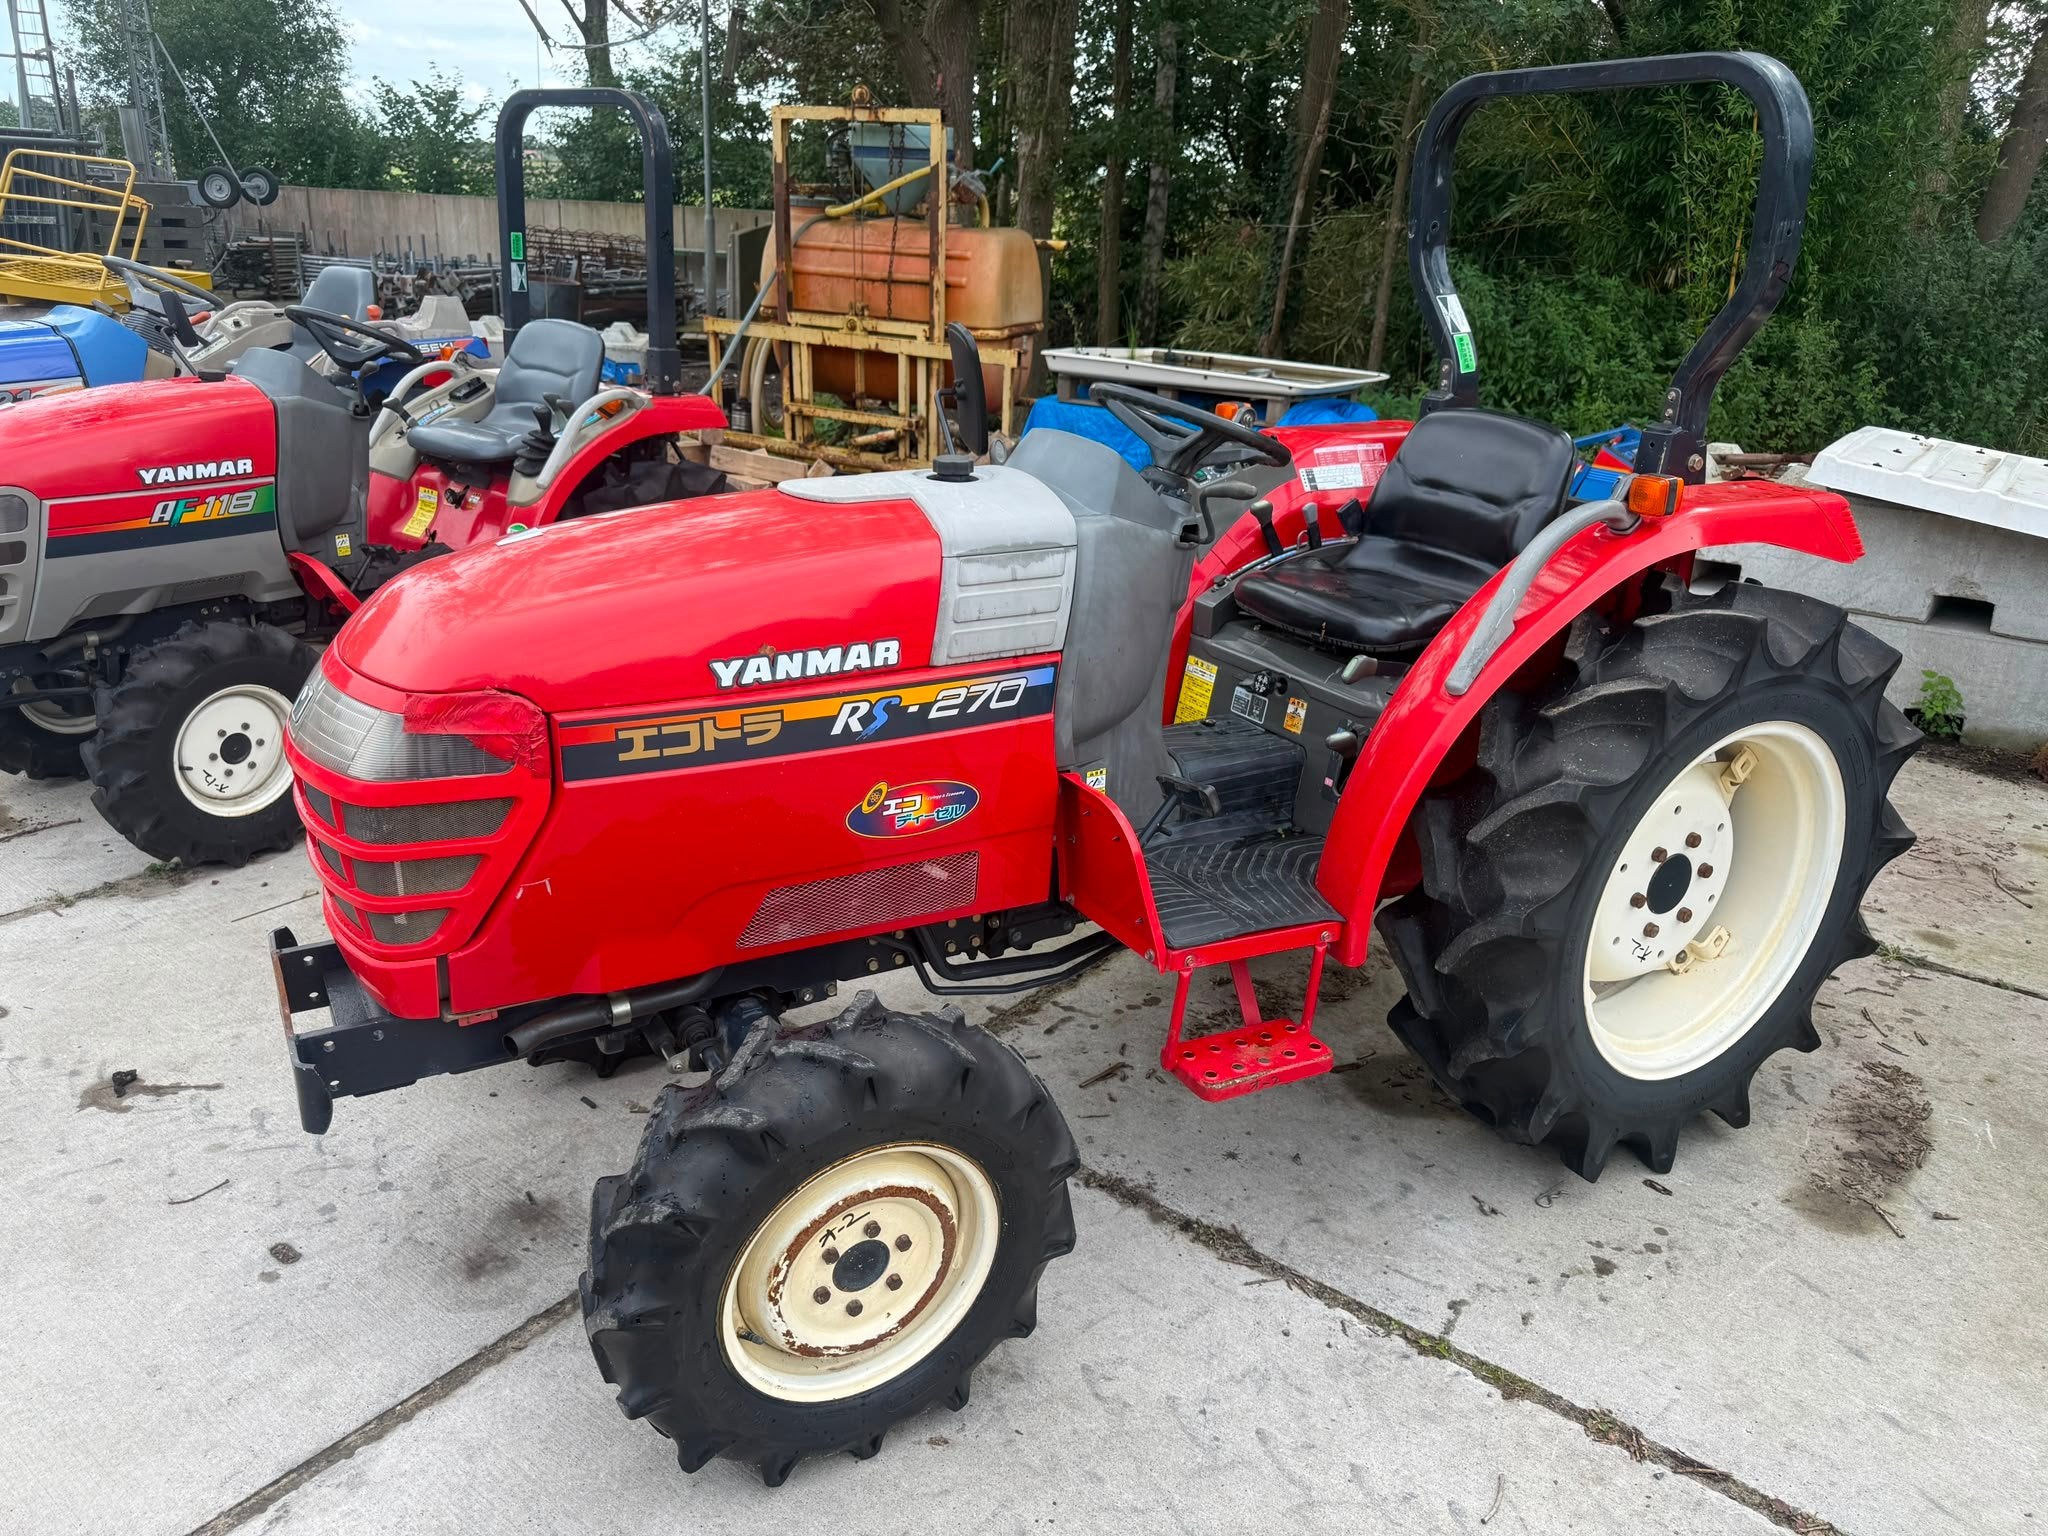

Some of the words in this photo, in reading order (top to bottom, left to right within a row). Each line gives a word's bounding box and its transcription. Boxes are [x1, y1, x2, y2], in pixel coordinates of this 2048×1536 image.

[138, 458, 254, 485] YANMAR
[711, 638, 901, 689] YANMAR
[617, 711, 783, 762] エコトラ
[882, 794, 923, 816] エコ
[895, 804, 966, 829] ディーゼル
